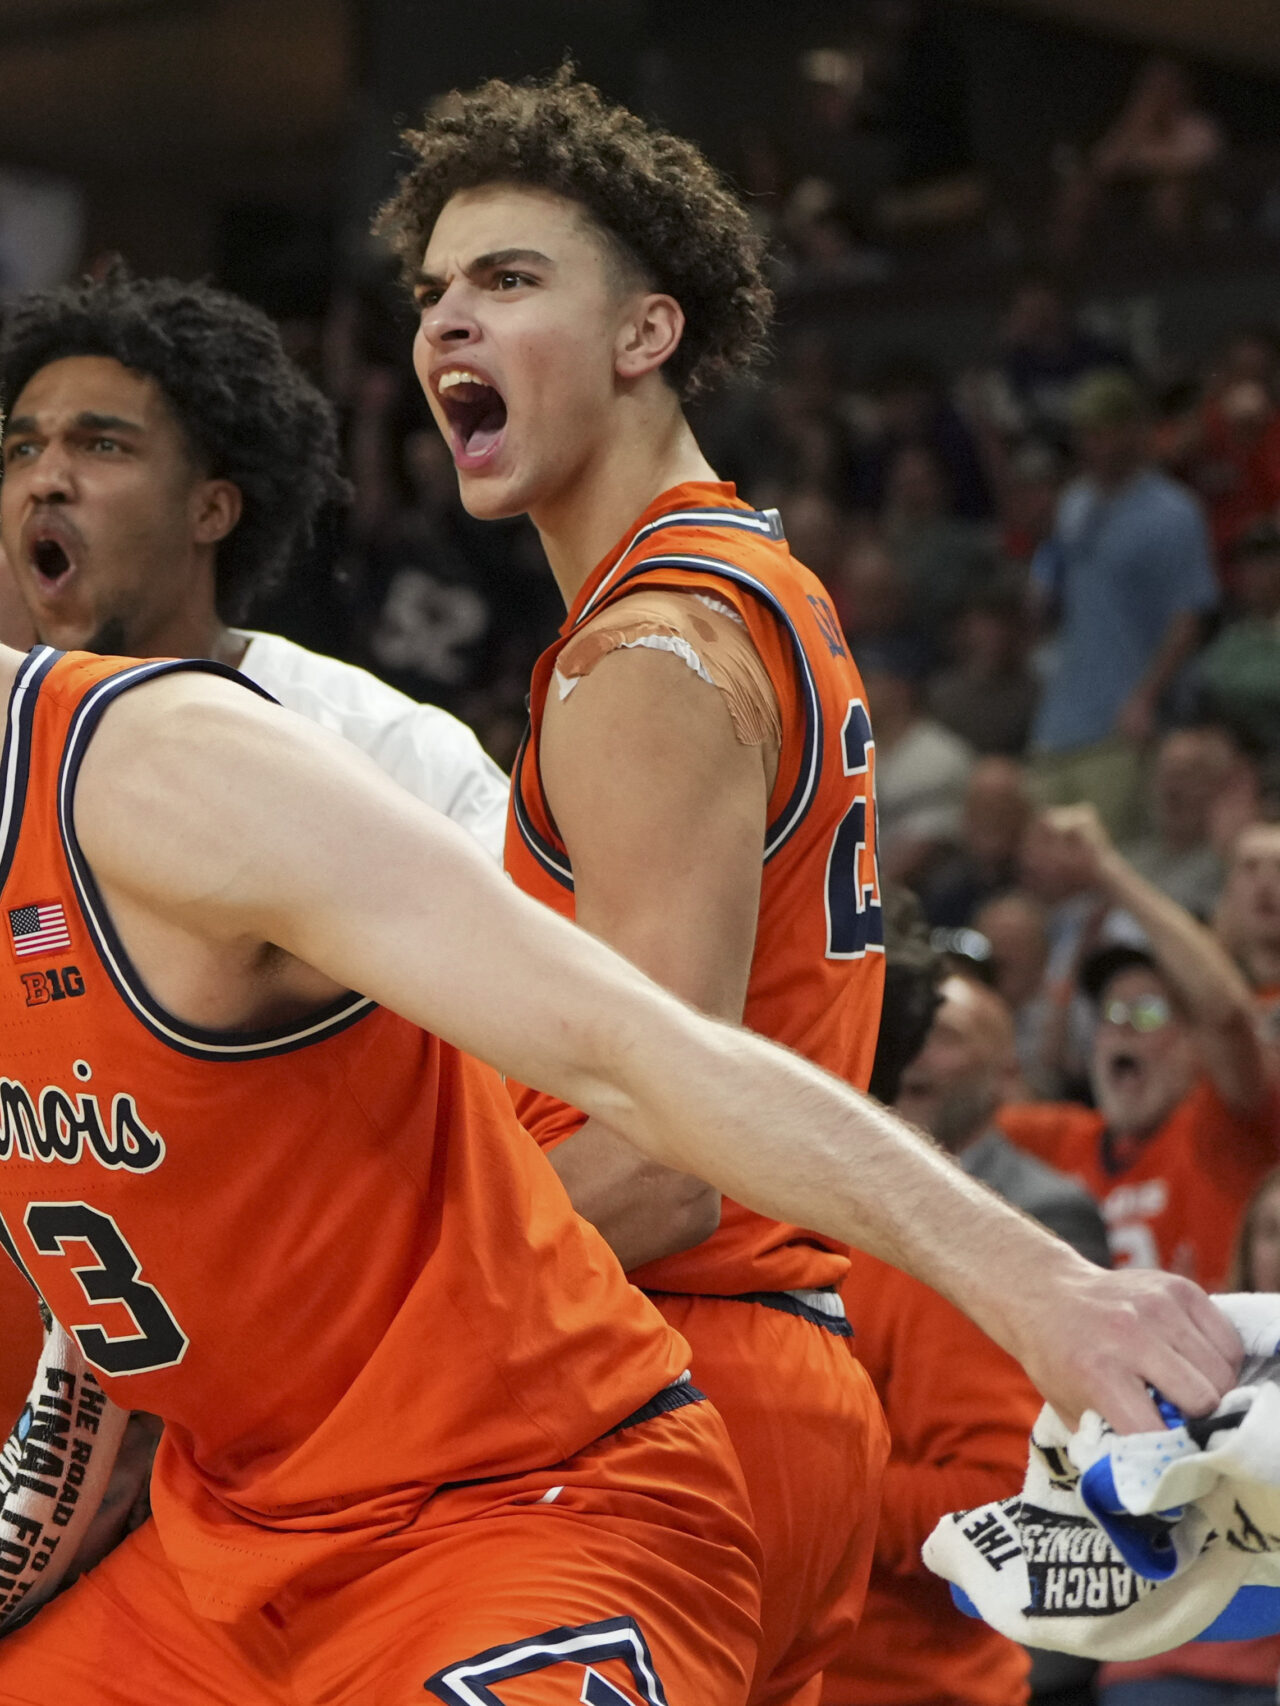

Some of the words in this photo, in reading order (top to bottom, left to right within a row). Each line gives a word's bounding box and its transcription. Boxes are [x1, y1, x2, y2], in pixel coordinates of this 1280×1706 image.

[8, 1366, 77, 1499] FINAL
[52, 1437, 93, 1528] ROAD
[31, 1534, 61, 1573] TO
[962, 1511, 1023, 1572] THE
